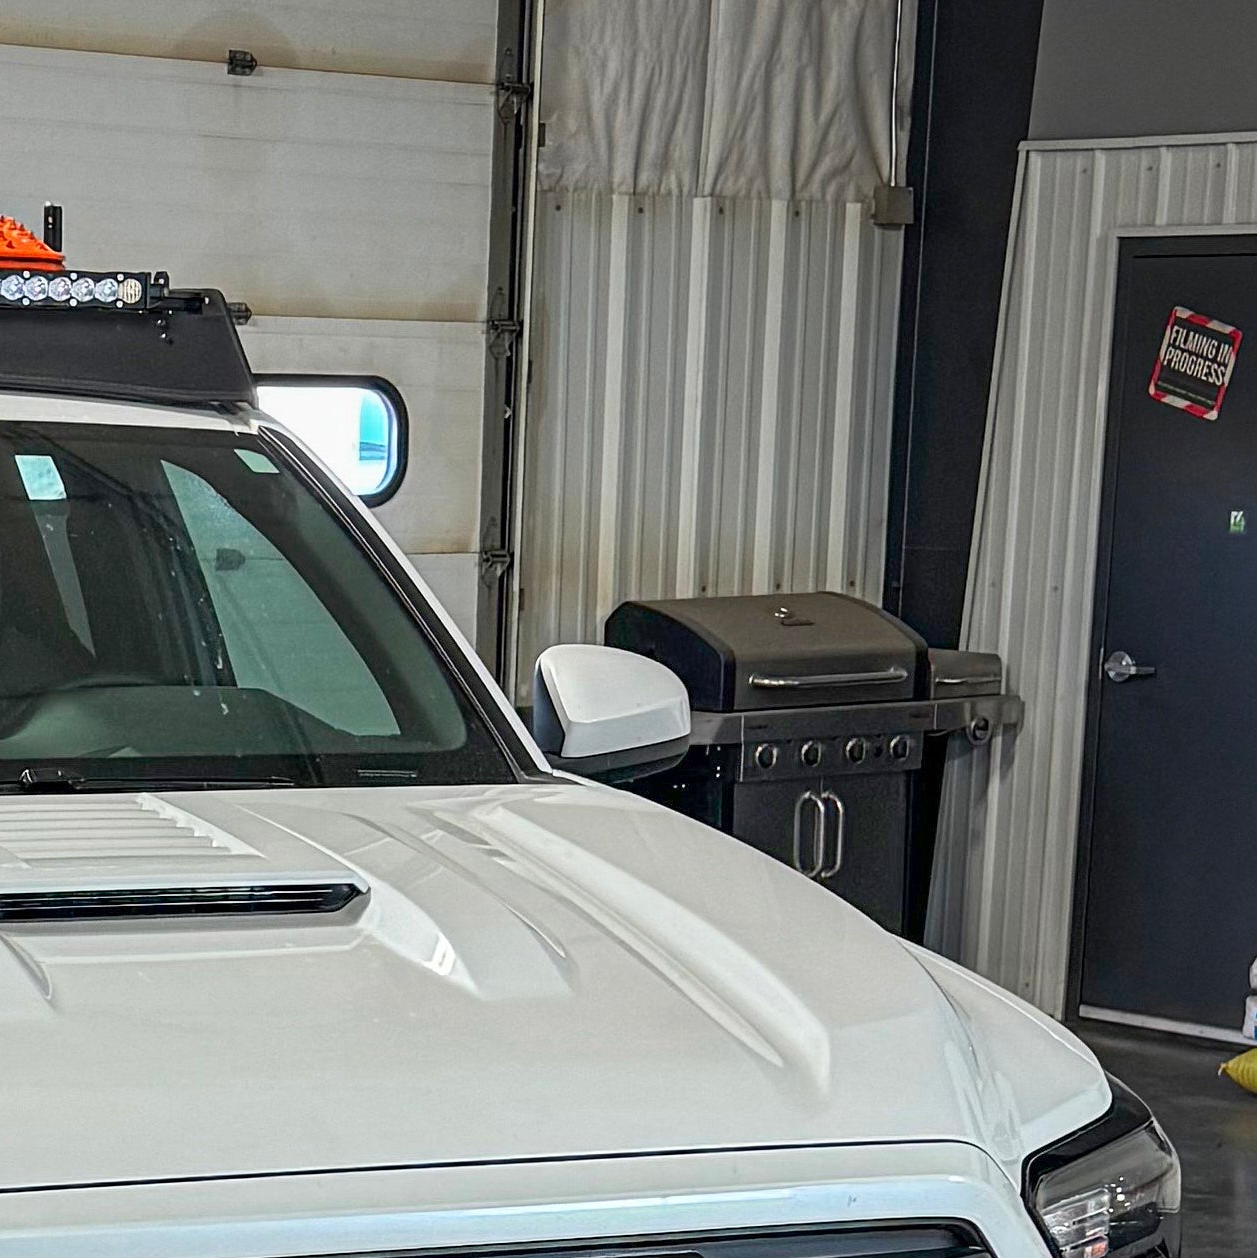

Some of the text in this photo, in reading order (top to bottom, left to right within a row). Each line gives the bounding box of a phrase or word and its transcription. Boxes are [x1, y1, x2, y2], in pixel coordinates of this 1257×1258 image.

[1170, 325, 1233, 364] FILMING IN
[1163, 346, 1226, 386] PROGRESS
